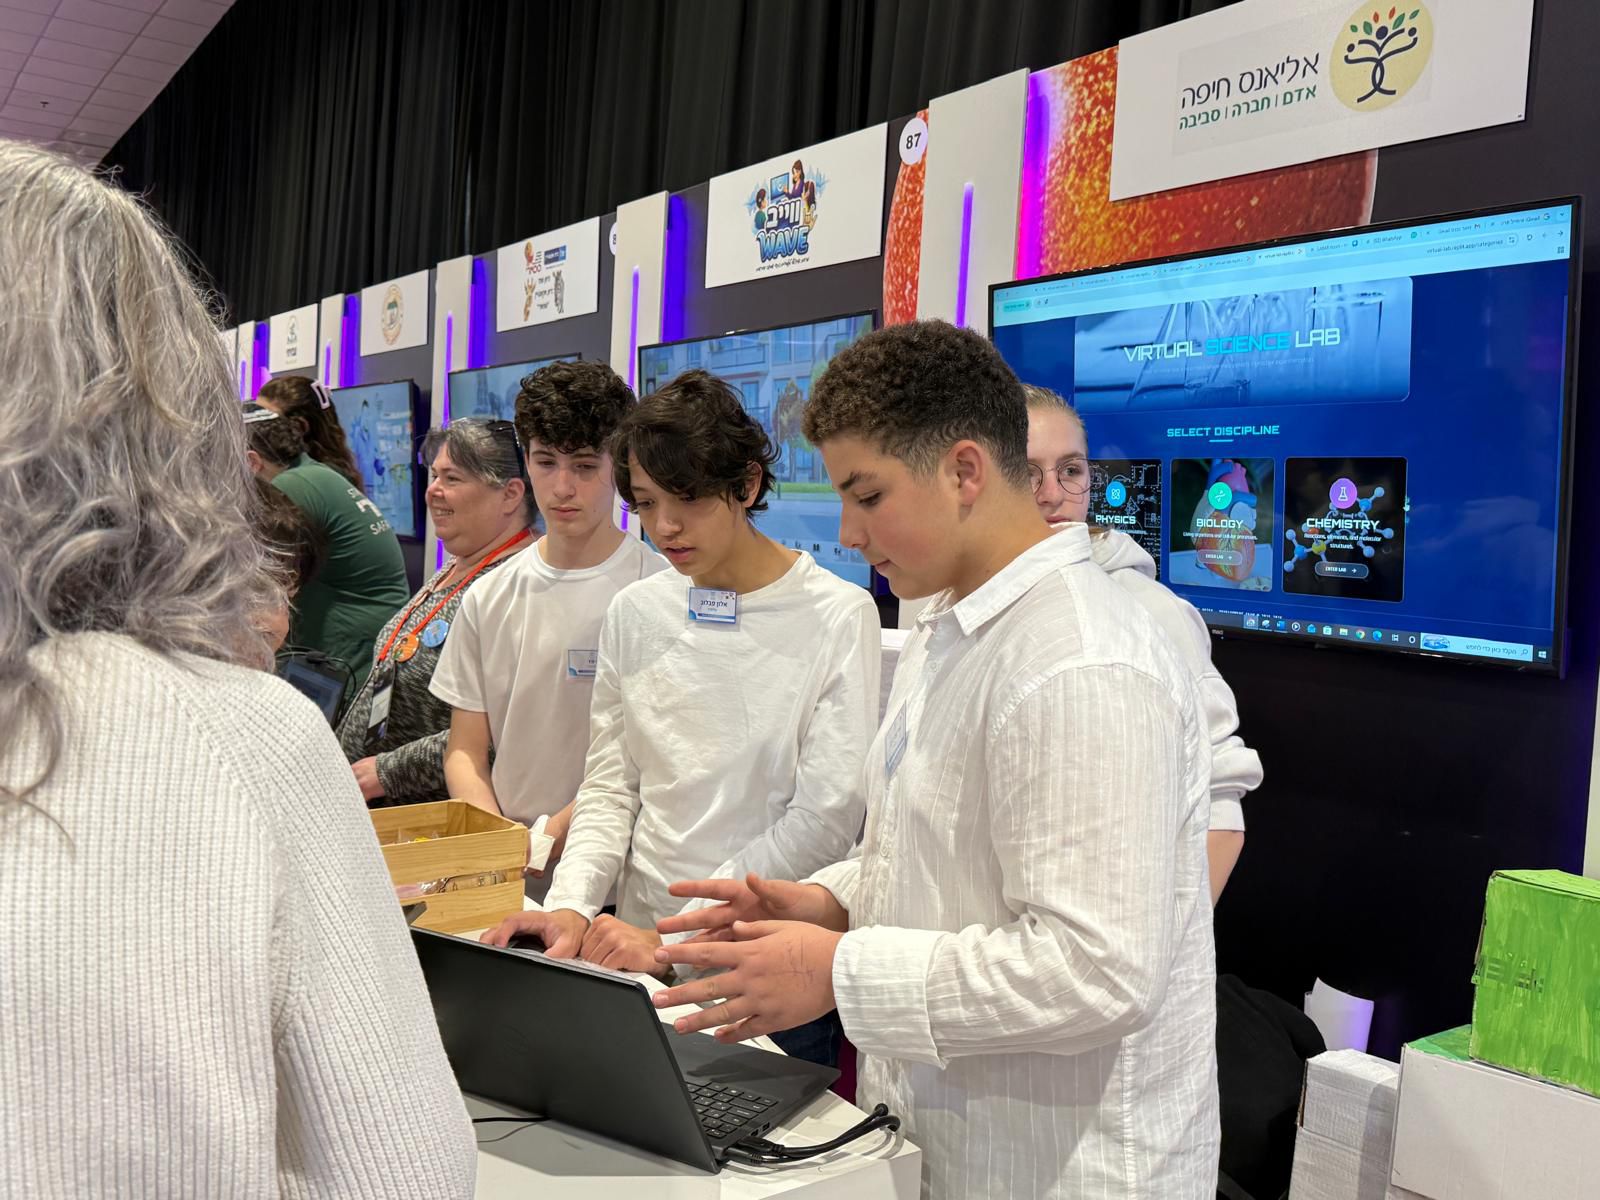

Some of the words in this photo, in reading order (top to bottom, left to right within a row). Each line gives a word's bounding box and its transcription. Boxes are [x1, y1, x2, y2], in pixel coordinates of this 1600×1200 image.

[1238, 52, 1320, 94] אליאנס
[1181, 77, 1231, 109] חיפה
[1282, 85, 1318, 106] אדם
[1231, 96, 1271, 118] חברה
[1179, 108, 1221, 130] סביבה
[906, 132, 922, 150] 87
[756, 226, 810, 262] WAVE
[1124, 341, 1202, 362] VIRTUAL
[1205, 332, 1292, 356] SCIENCE
[1295, 328, 1341, 348] LAB
[1167, 427, 1211, 437] SELECT
[1214, 425, 1280, 436] DISCIPLINE
[1095, 514, 1136, 525] PHYSICS
[1196, 518, 1244, 529] BIOLOGY
[1306, 517, 1380, 533] CHEMISTRY
